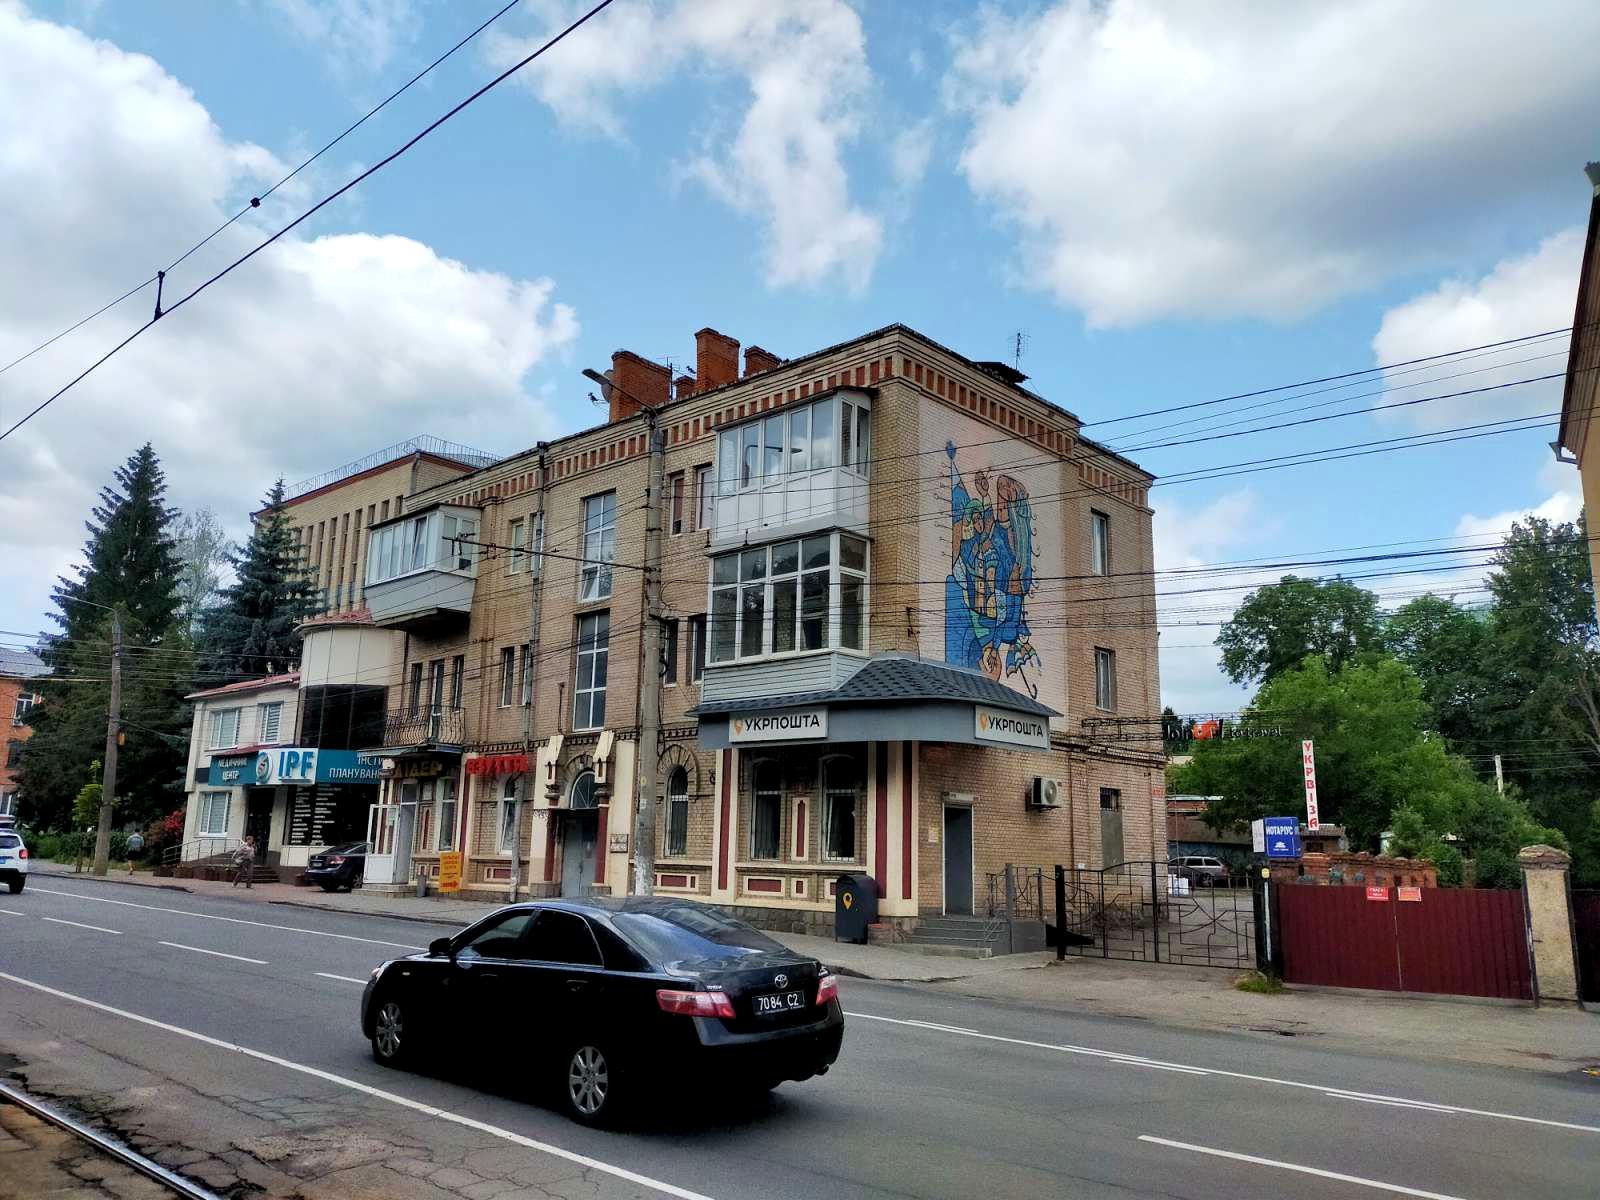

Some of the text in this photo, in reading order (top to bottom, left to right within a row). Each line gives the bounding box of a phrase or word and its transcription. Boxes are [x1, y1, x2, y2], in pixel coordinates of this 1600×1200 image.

[745, 714, 820, 731] УКРПОШТА
[988, 715, 1043, 737] УКРПОШТА
[279, 751, 314, 779] IPF
[1304, 742, 1318, 828] УКРВІЗА
[758, 995, 783, 1011] 7084
